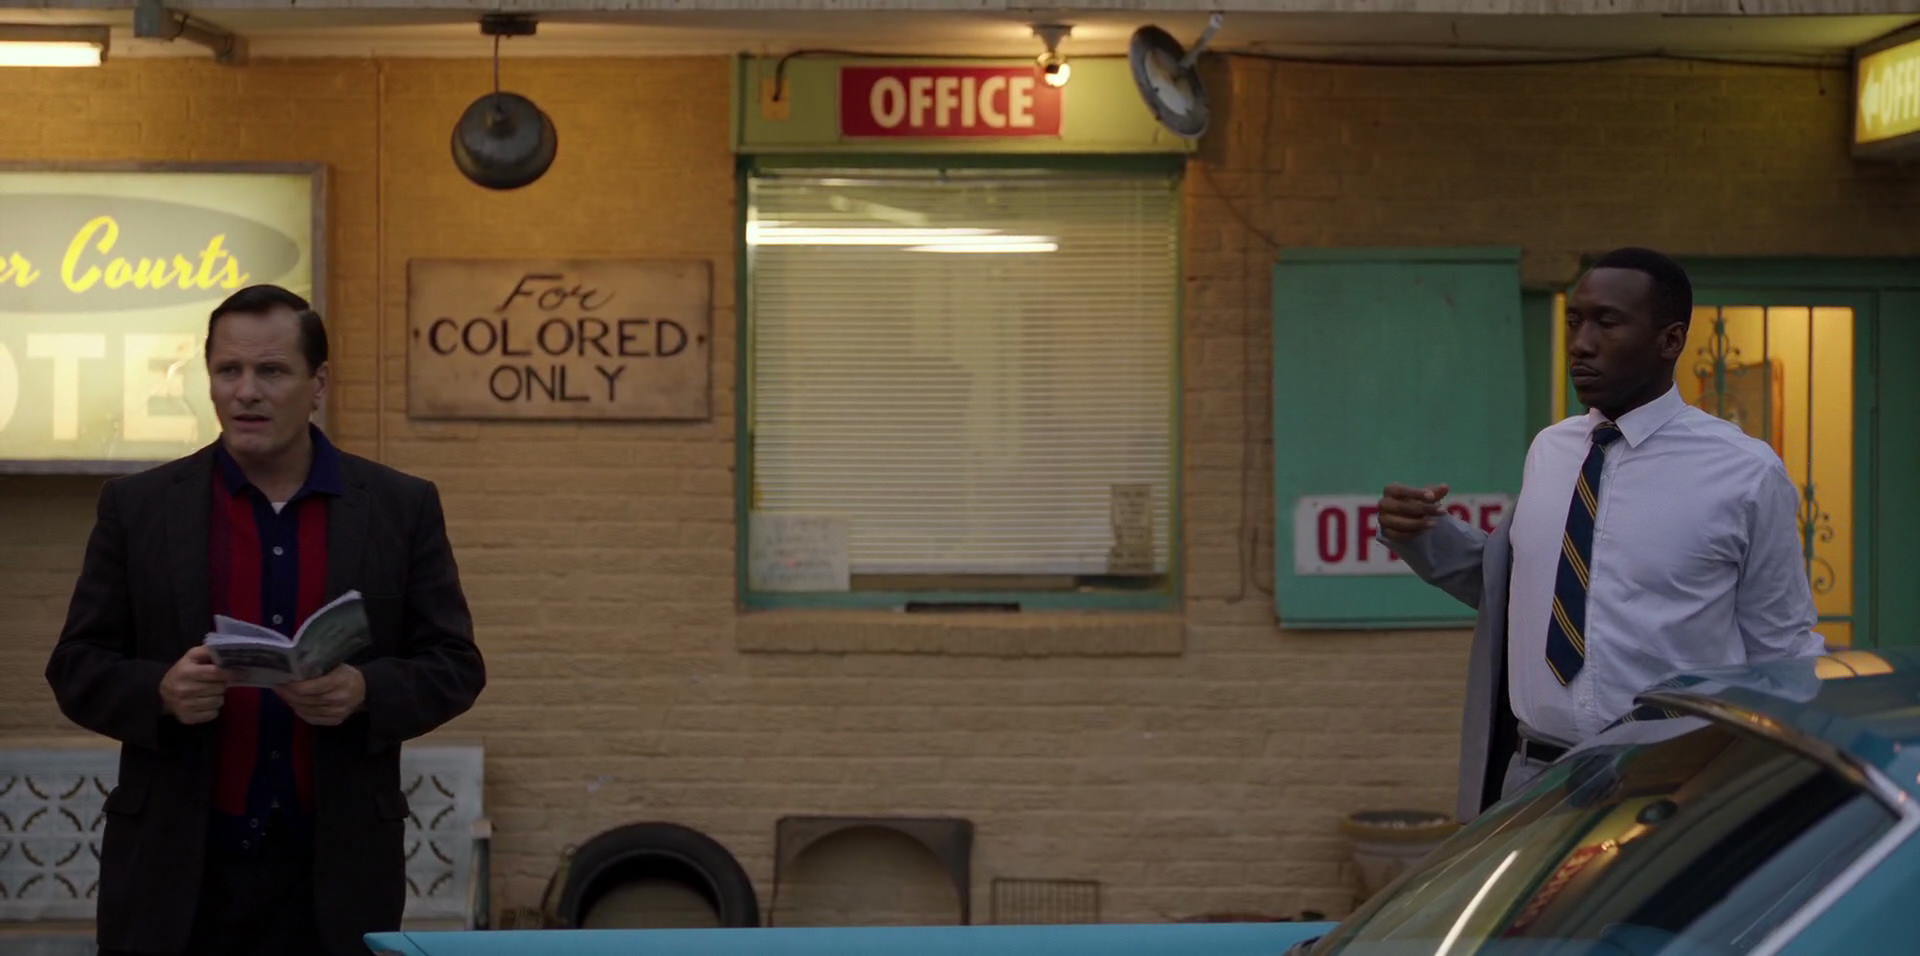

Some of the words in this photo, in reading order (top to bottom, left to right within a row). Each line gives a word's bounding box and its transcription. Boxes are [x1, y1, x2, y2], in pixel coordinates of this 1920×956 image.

[869, 76, 1035, 128] OFFICE
[61, 215, 249, 293] Courts
[495, 273, 616, 312] For
[428, 317, 688, 357] COLORED
[0, 332, 198, 442] TE
[489, 364, 626, 402] ONLY
